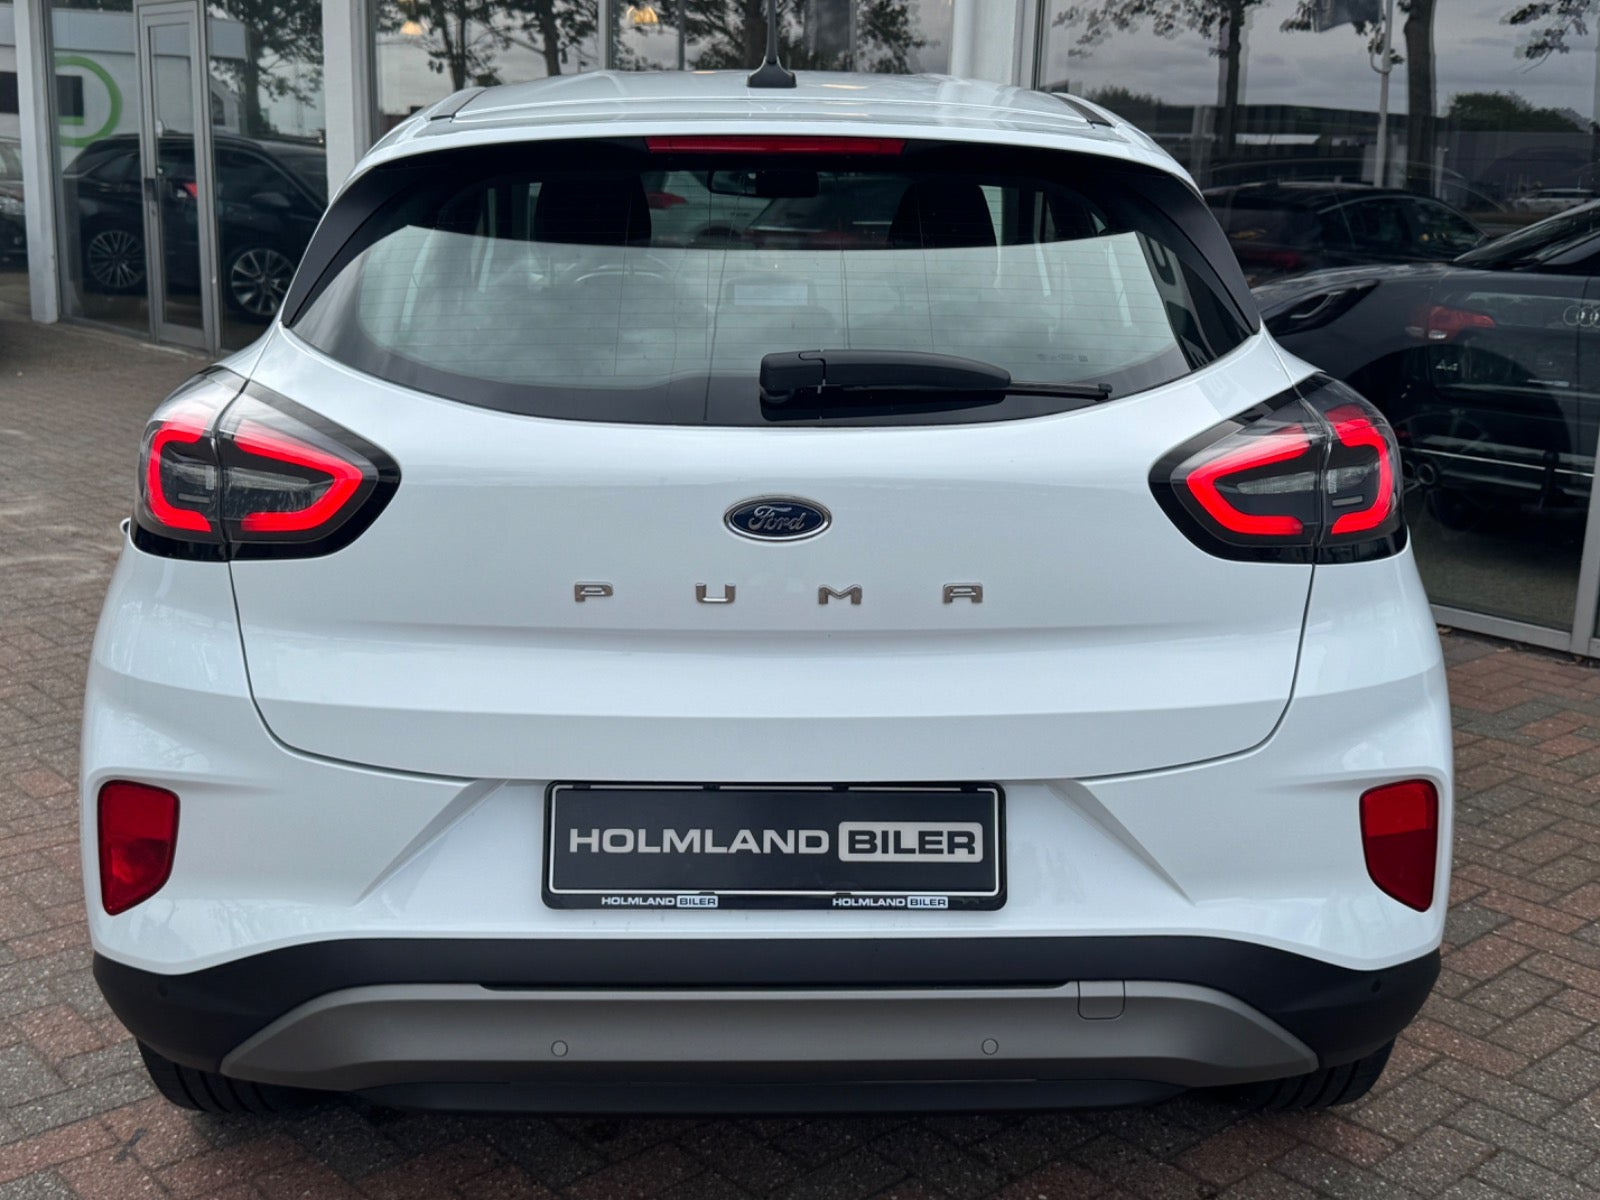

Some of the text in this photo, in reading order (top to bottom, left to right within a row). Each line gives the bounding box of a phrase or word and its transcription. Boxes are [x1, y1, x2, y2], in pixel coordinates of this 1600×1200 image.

[748, 505, 806, 531] Ford
[569, 828, 976, 855] HOLMLAND BILER
[600, 896, 717, 907] HOLMLAND BILER
[832, 897, 947, 907] HOLMLAND BILER
